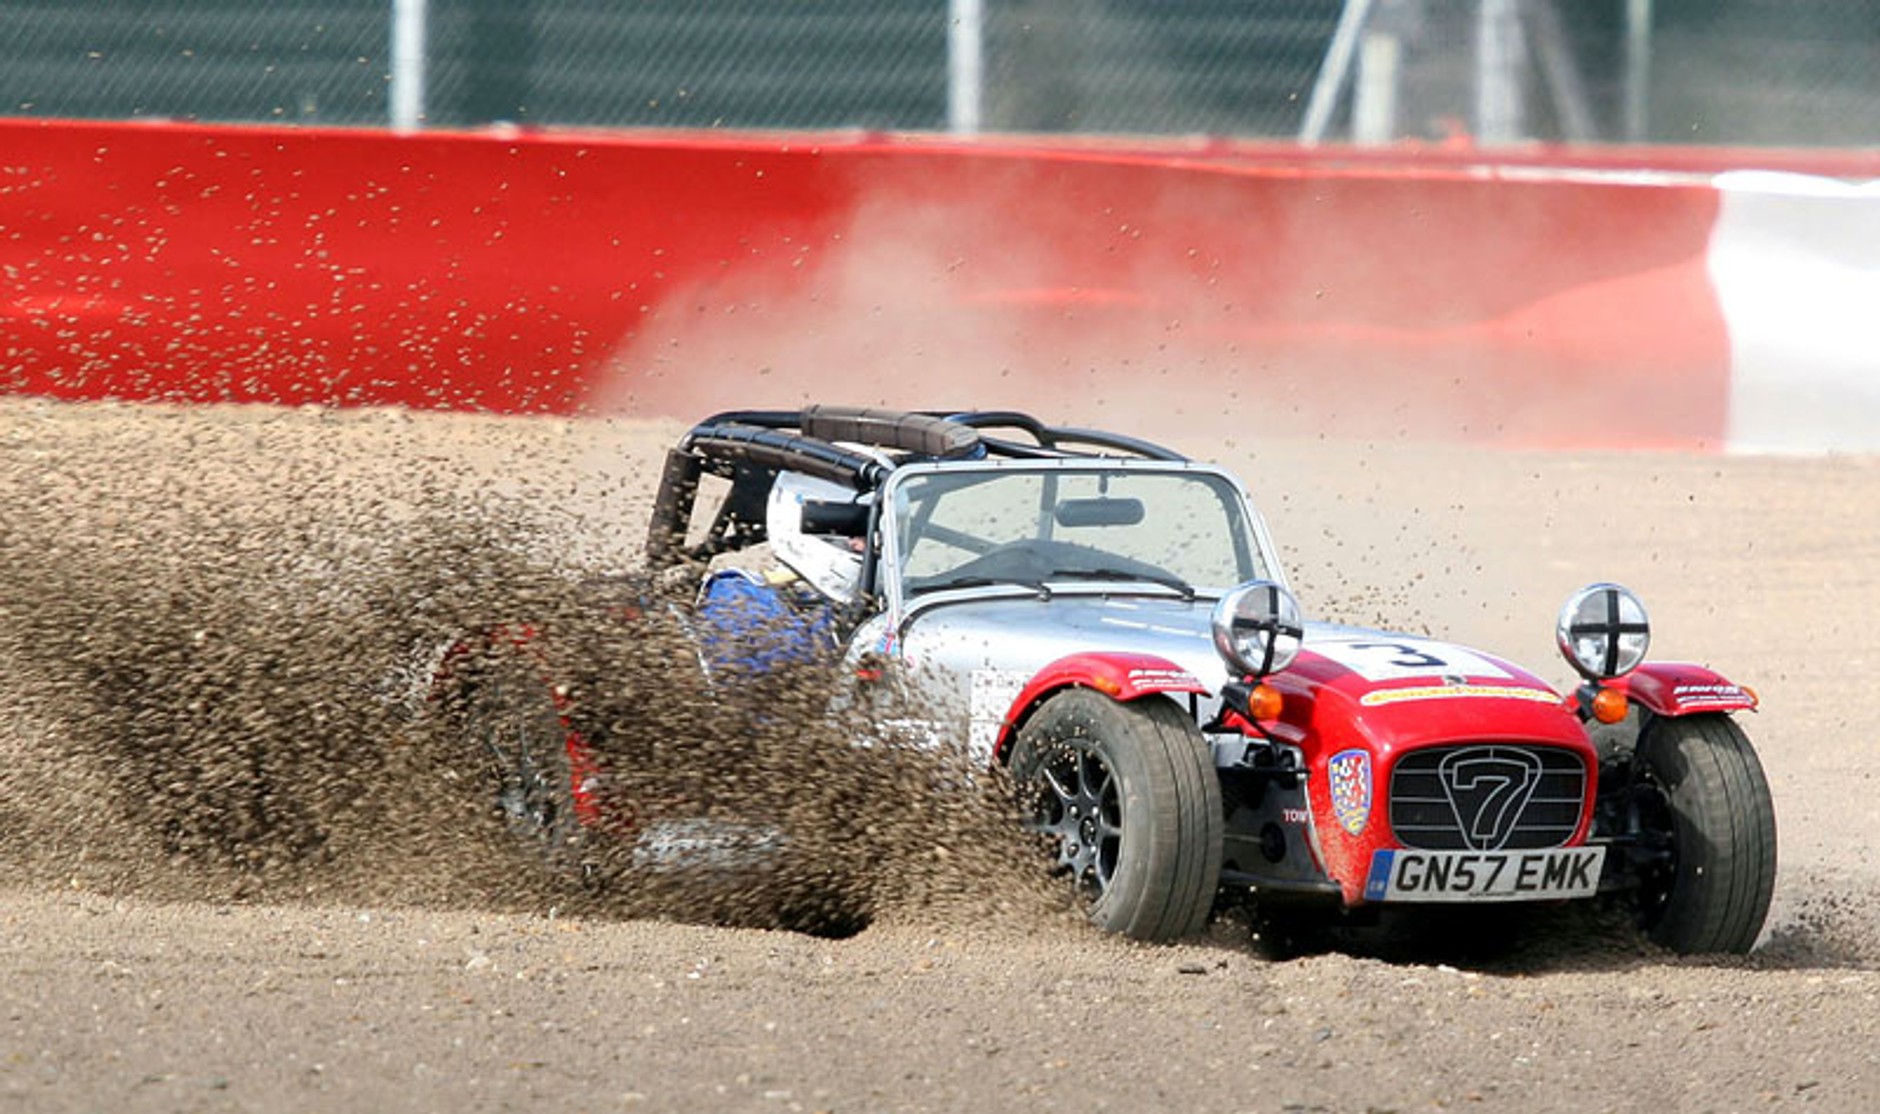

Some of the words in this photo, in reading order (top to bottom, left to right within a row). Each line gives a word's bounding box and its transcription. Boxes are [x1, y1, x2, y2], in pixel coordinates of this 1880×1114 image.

[1349, 644, 1448, 668] 3
[1452, 758, 1529, 838] 7
[1396, 856, 1507, 891] GN57
[1515, 853, 1597, 890] EMK
